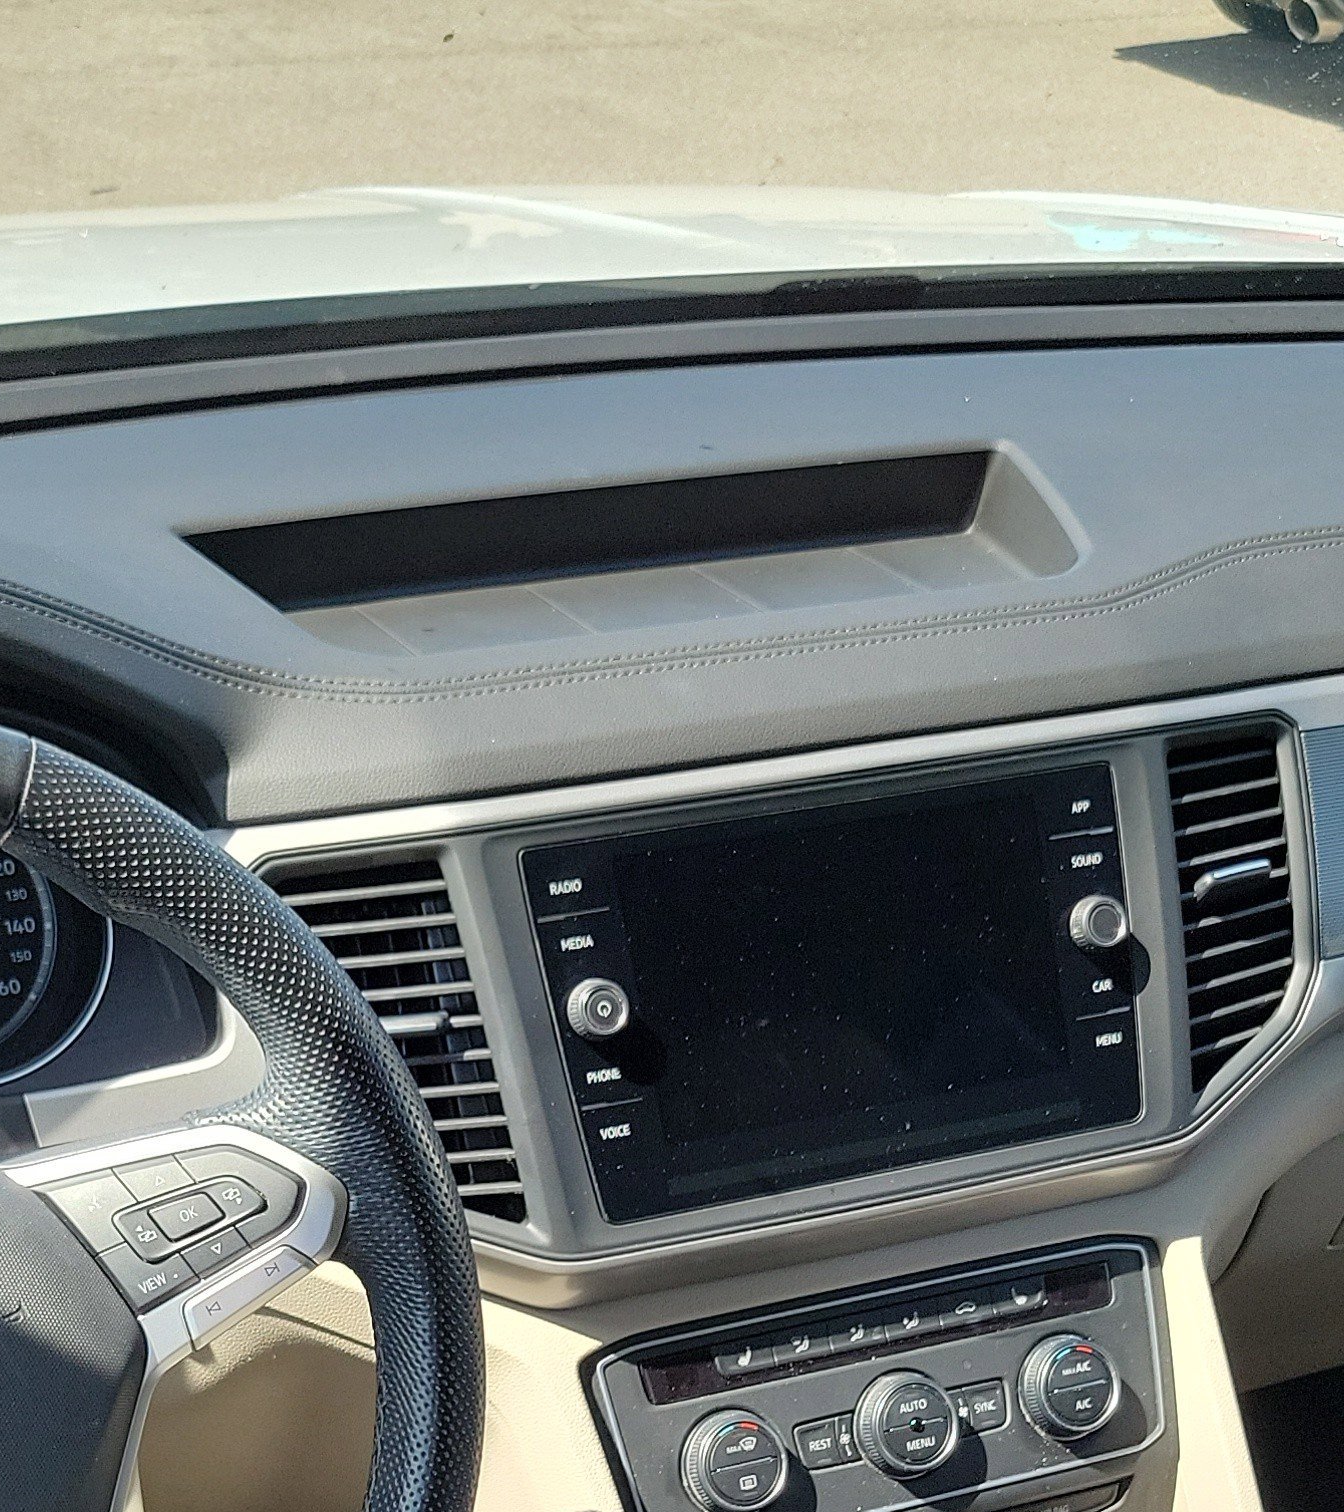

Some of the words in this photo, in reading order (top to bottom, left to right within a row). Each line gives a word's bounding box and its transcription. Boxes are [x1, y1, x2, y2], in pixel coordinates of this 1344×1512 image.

[1071, 799, 1091, 814] APP
[1071, 852, 1103, 869] SOUND
[6, 887, 28, 902] 130
[549, 878, 582, 896] RADIO
[5, 916, 36, 936] 140
[560, 934, 594, 952] MEDIA
[10, 950, 32, 964] 150
[1092, 978, 1114, 993] CAR
[1095, 1031, 1123, 1048] MENU
[586, 1066, 622, 1085] PHONE
[599, 1123, 632, 1141] VOICE
[179, 1206, 199, 1223] OK
[138, 1273, 167, 1295] VIEW
[1075, 1359, 1092, 1374] A/C
[899, 1399, 928, 1415] AUTO
[974, 1400, 997, 1415] SYNC
[1075, 1397, 1093, 1412] A/C
[808, 1438, 832, 1452] REST
[906, 1436, 936, 1452] MENU
